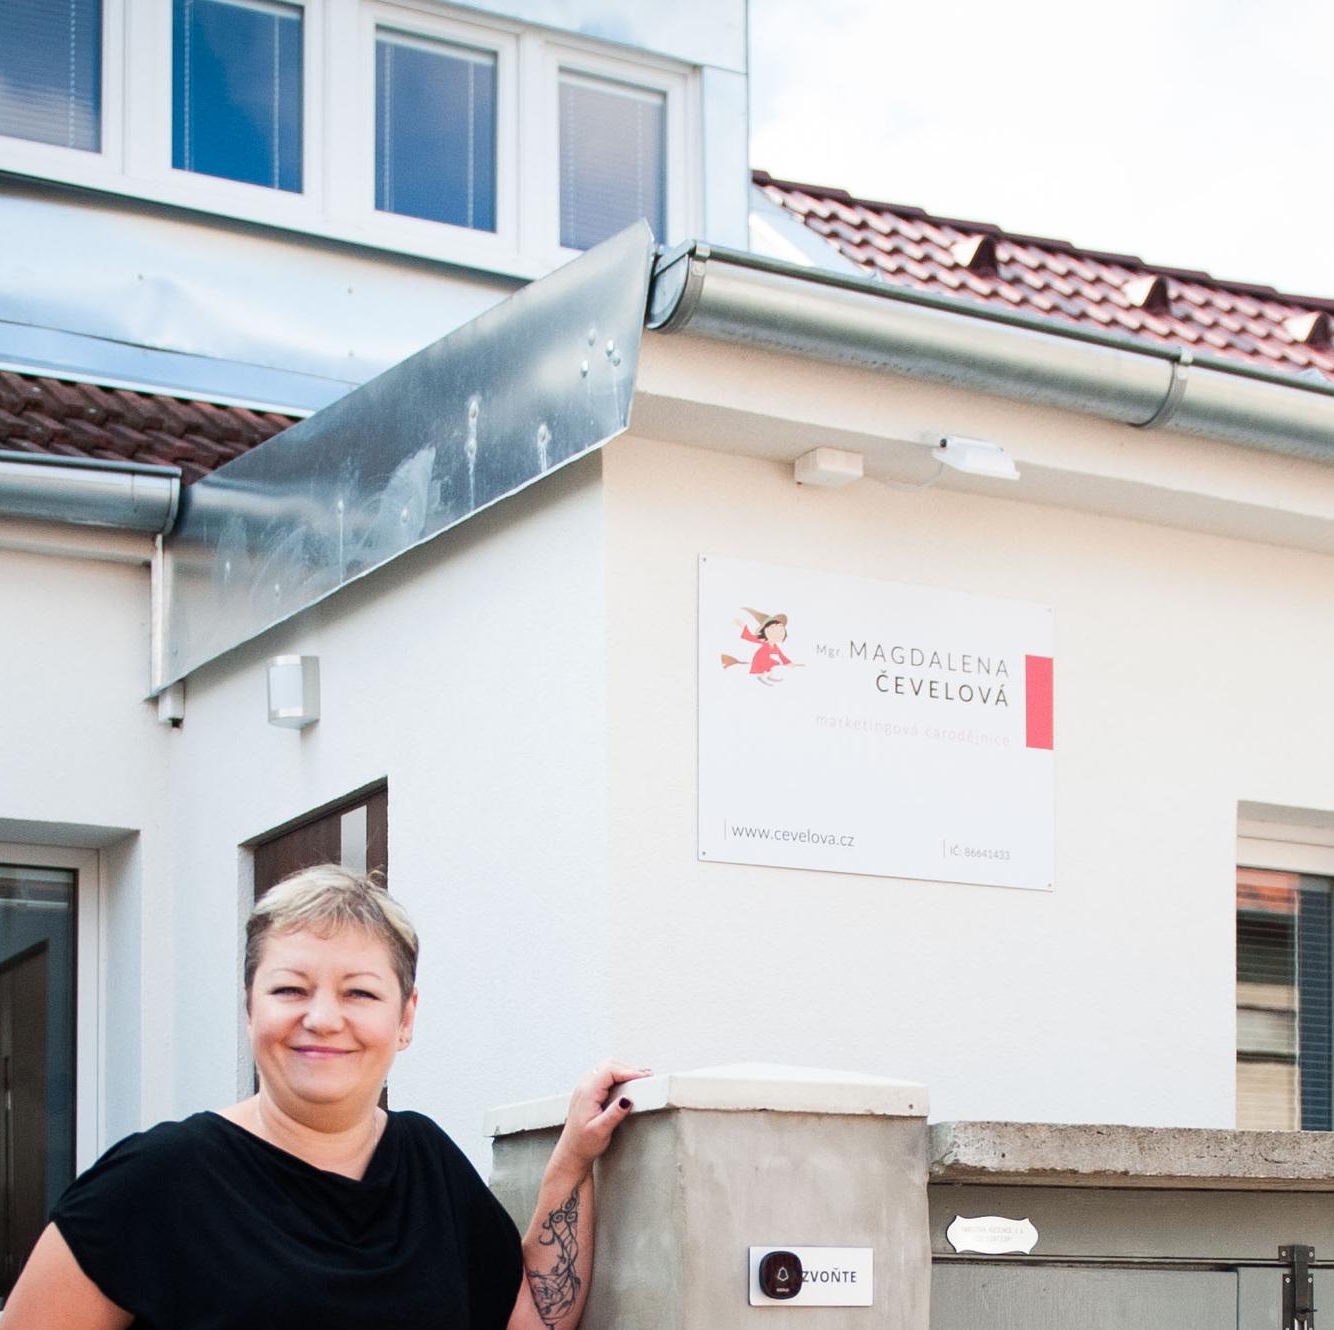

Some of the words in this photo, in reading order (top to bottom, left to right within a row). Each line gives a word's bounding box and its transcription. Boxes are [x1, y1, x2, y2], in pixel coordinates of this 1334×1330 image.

[816, 643, 844, 659] Mgr.
[849, 640, 1010, 678] MAGDALENA
[875, 669, 1010, 707] ČEVELOVÁ
[815, 714, 919, 738] marketingová
[731, 825, 855, 847] www.cevelova.cz
[801, 1267, 858, 1284] ZVOŇTE
